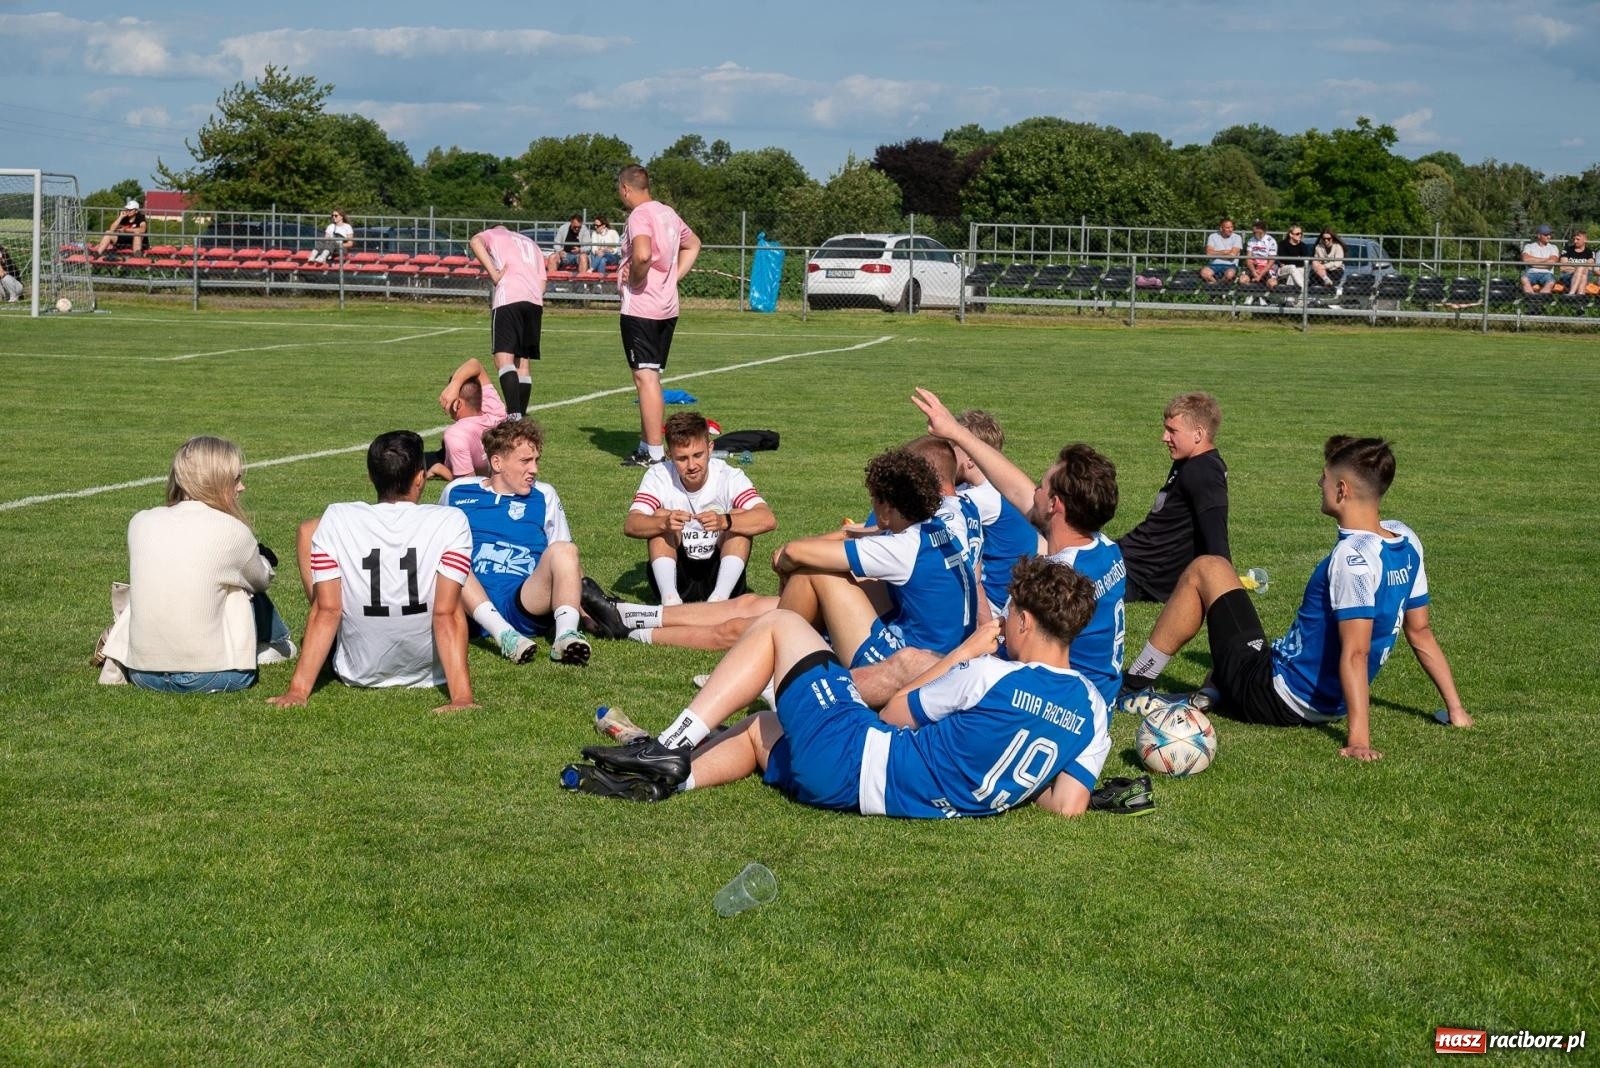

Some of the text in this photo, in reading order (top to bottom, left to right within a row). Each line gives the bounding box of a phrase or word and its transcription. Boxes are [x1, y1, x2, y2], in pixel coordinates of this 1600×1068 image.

[362, 547, 428, 617] 11
[944, 551, 970, 627] 7
[1111, 597, 1126, 675] 8
[1011, 688, 1043, 716] UNIA
[971, 727, 1059, 813] 19
